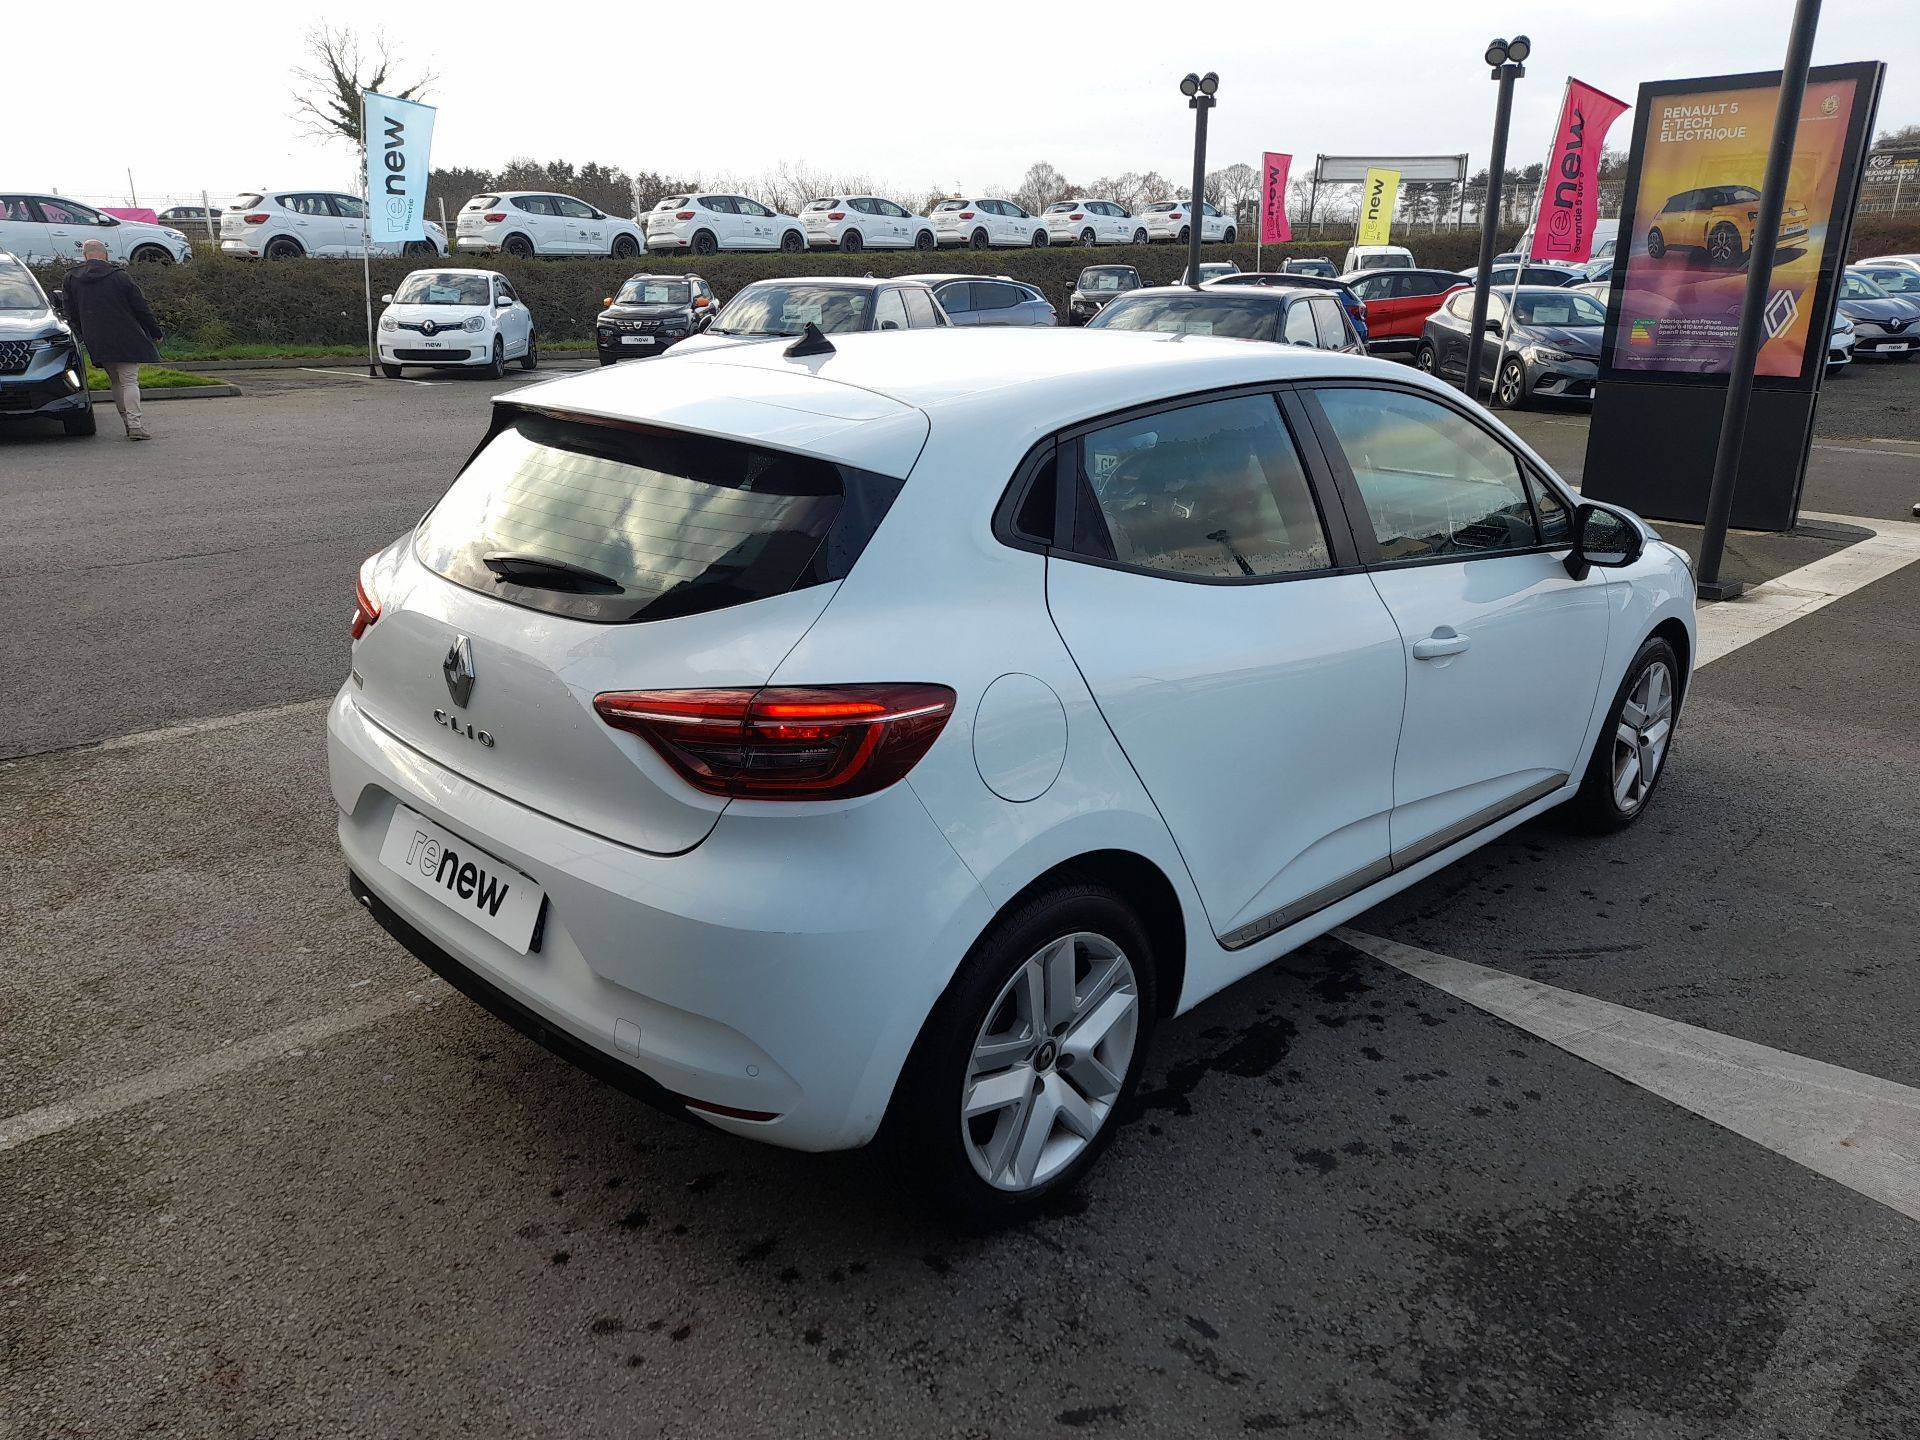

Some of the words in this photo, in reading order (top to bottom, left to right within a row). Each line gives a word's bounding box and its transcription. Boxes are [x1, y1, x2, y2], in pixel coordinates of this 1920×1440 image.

[1661, 116, 1713, 131] E-TECH
[1663, 103, 1728, 119] RENAULT
[1730, 102, 1739, 114] 5
[384, 115, 406, 232] renew
[1547, 108, 1585, 252] renew
[1576, 179, 1584, 198] sur
[404, 198, 414, 231] electric
[1268, 165, 1280, 239] renew
[1363, 178, 1385, 241] renew
[1573, 208, 1583, 253] garantie
[433, 707, 495, 748] CLIO
[405, 830, 510, 917] renew
